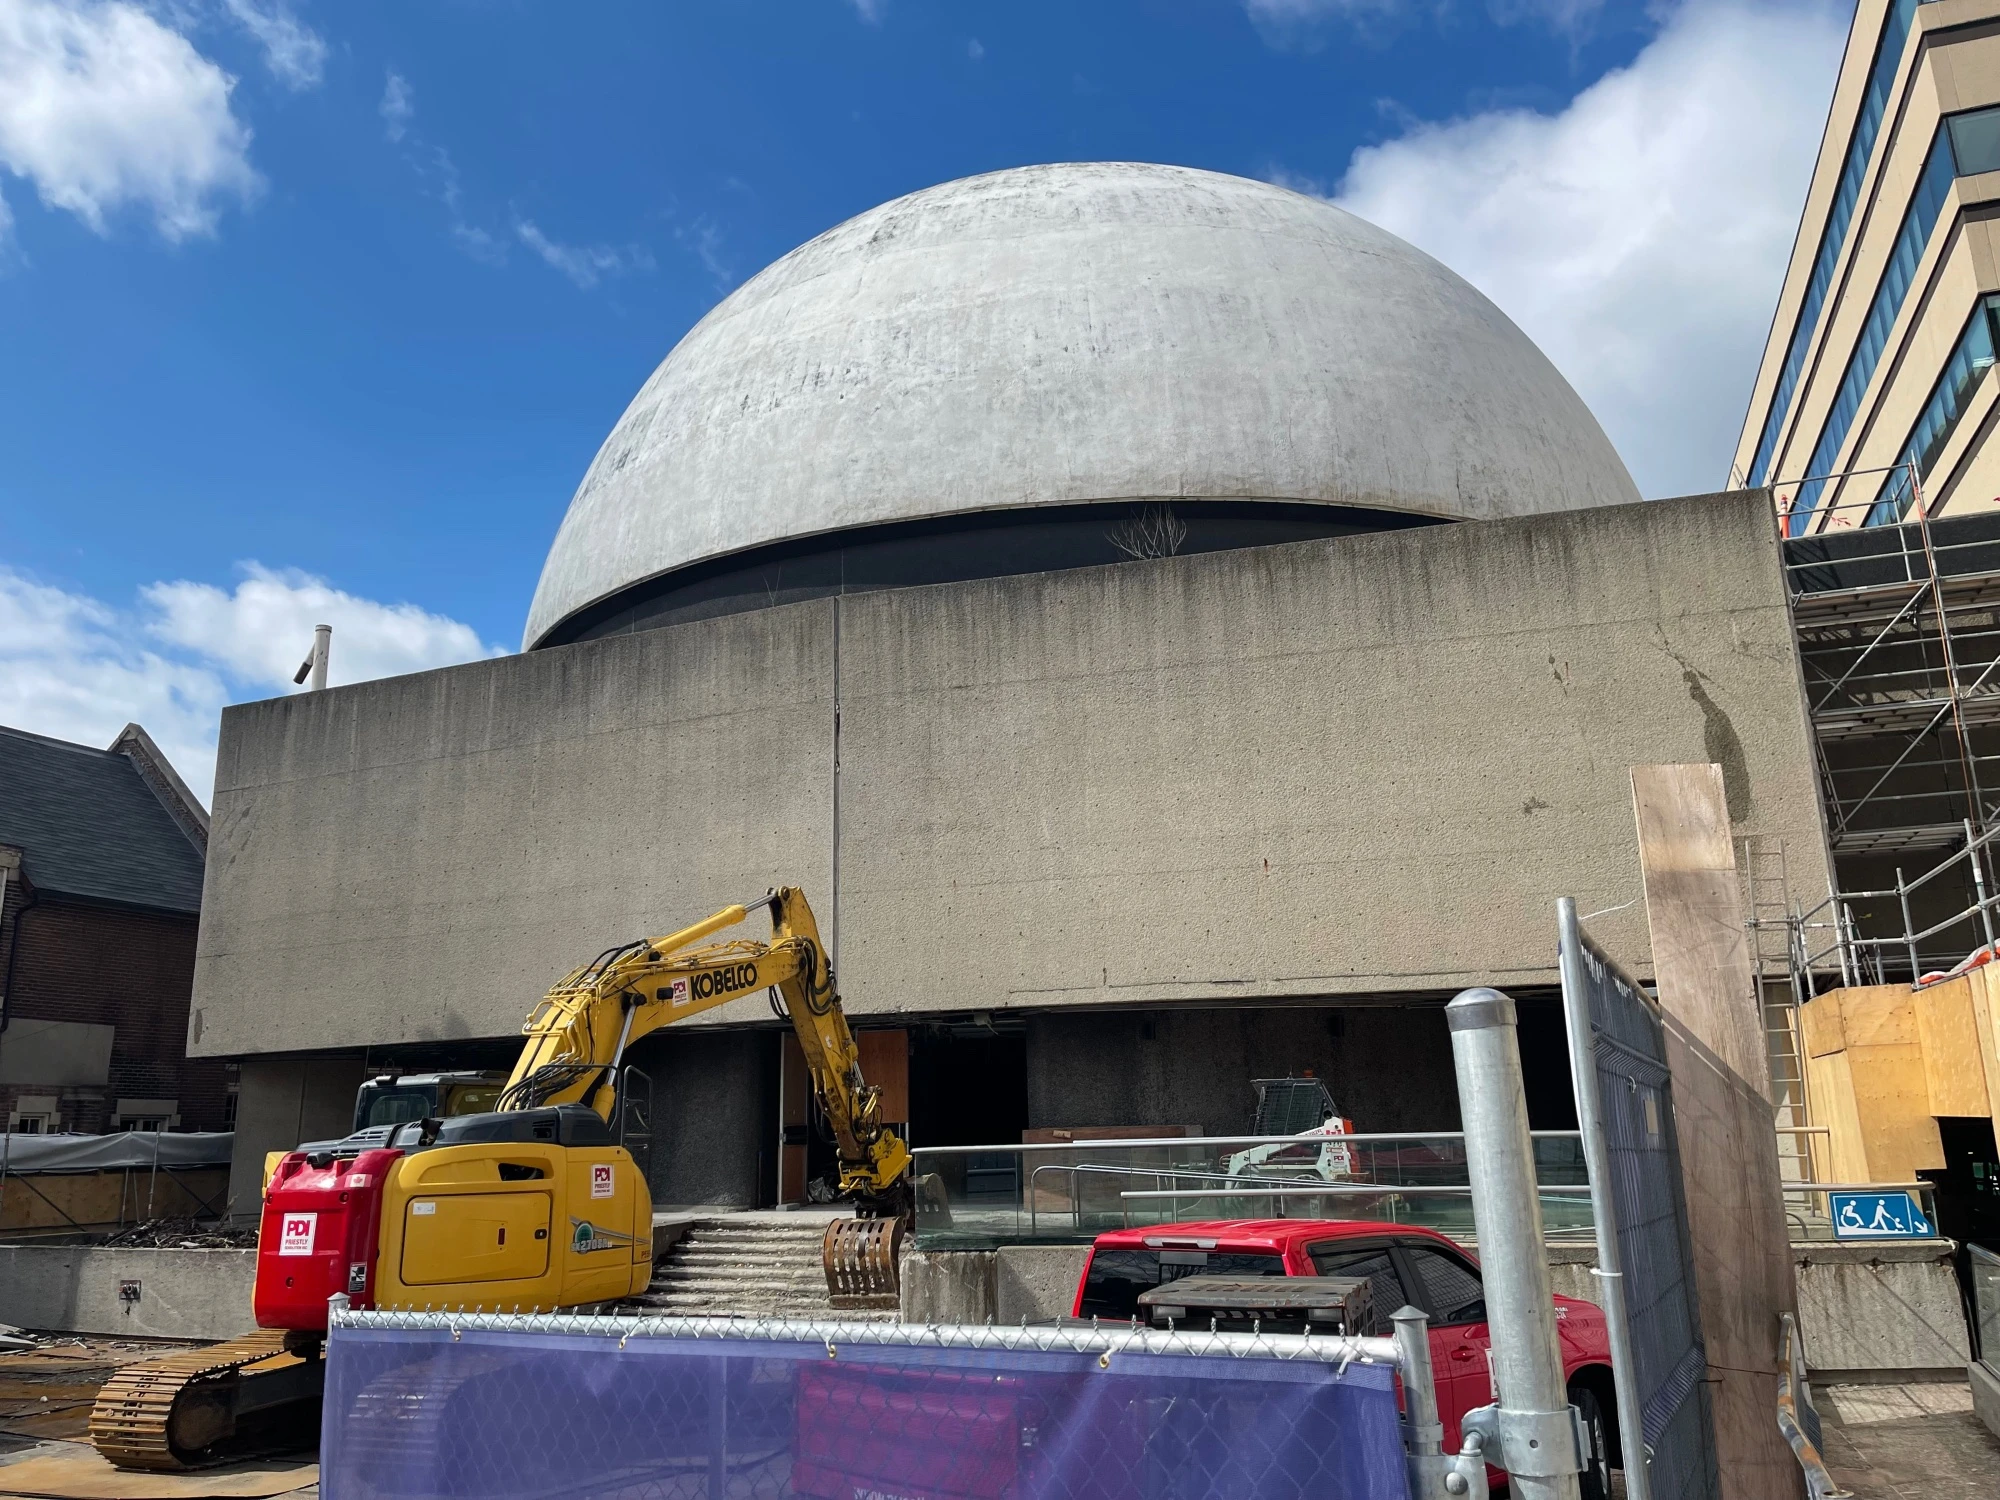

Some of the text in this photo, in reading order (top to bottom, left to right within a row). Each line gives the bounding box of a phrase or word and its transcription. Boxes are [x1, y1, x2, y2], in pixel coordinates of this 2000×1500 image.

[674, 980, 687, 994] PDI
[690, 962, 758, 1001] KOBELCO
[594, 1166, 611, 1182] PDI
[286, 1220, 310, 1236] PDI
[285, 1238, 309, 1246] PRIESTLY
